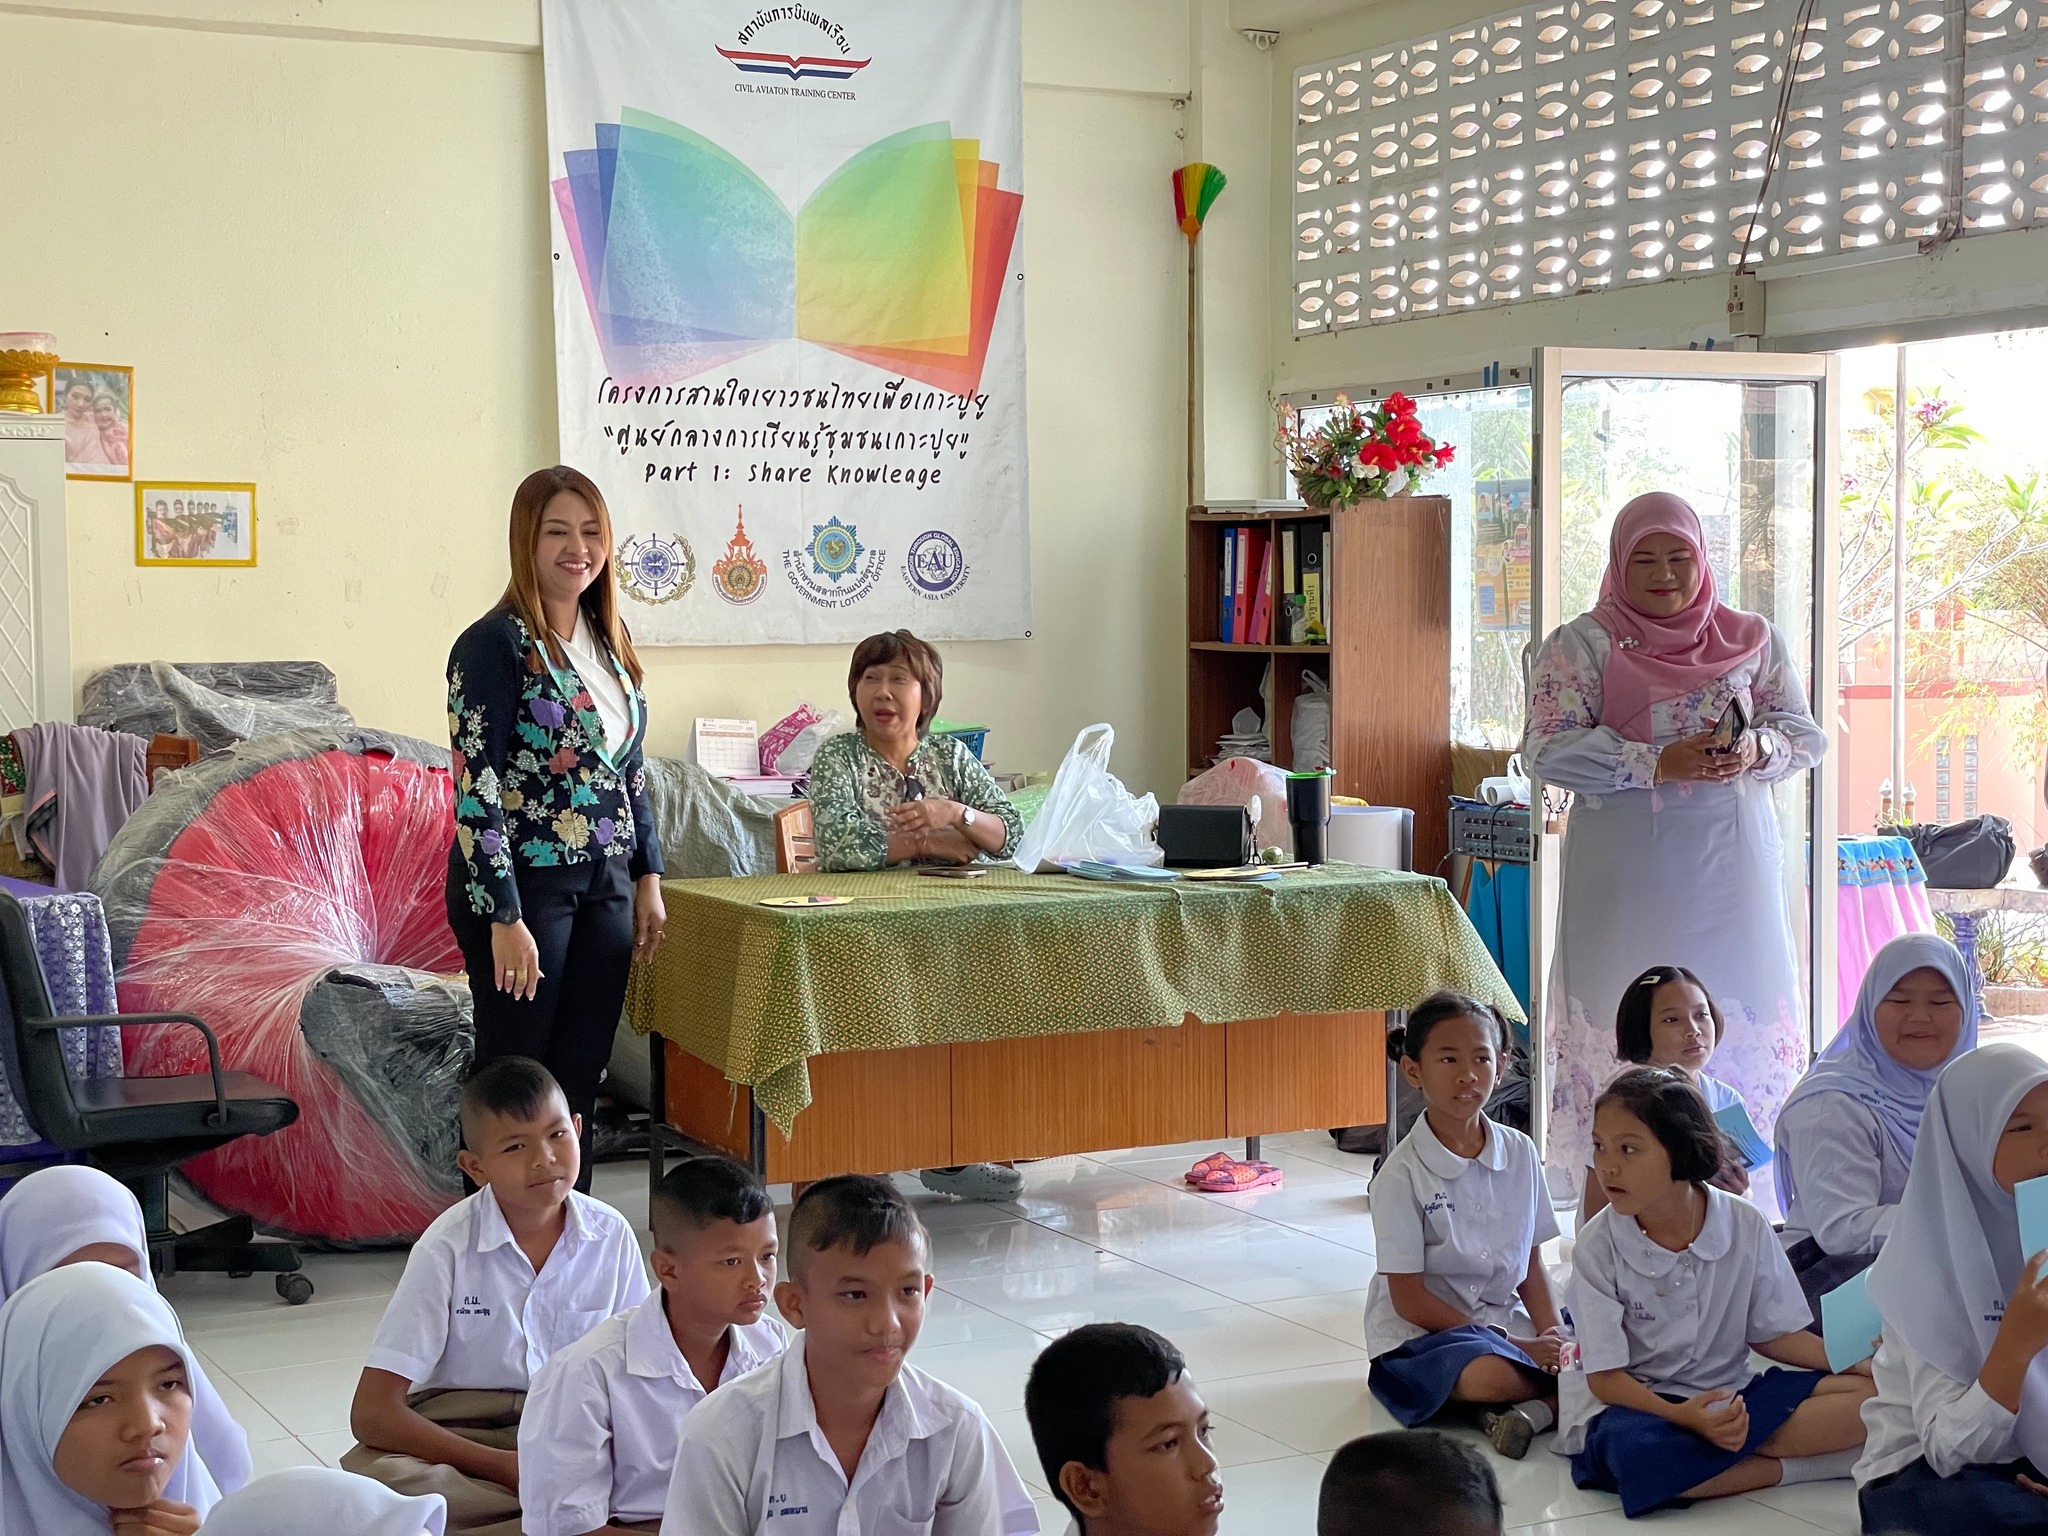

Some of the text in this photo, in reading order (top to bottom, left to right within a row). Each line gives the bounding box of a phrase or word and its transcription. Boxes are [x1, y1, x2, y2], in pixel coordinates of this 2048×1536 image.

[737, 3, 851, 54] สถาบันการบินพลเรือน
[735, 84, 754, 93] CIVIL
[790, 88, 826, 98] TRAINING
[827, 91, 856, 100] CENTER
[598, 377, 989, 420] โครงการสานใจเยาวชนไทยเพื่อเกาะปูยู
[713, 464, 730, 482] 1:
[748, 461, 812, 484] Share
[917, 550, 952, 571] EAU
[933, 532, 953, 547] GLOBAL
[950, 546, 961, 582] EDUCATION
[782, 549, 792, 569] THE
[787, 571, 837, 609] GOVERNMENT
[840, 582, 874, 608] LOTTERY
[872, 549, 886, 582] OFFICE
[900, 564, 971, 601] EASTERN ASIA UNIVERSITY
